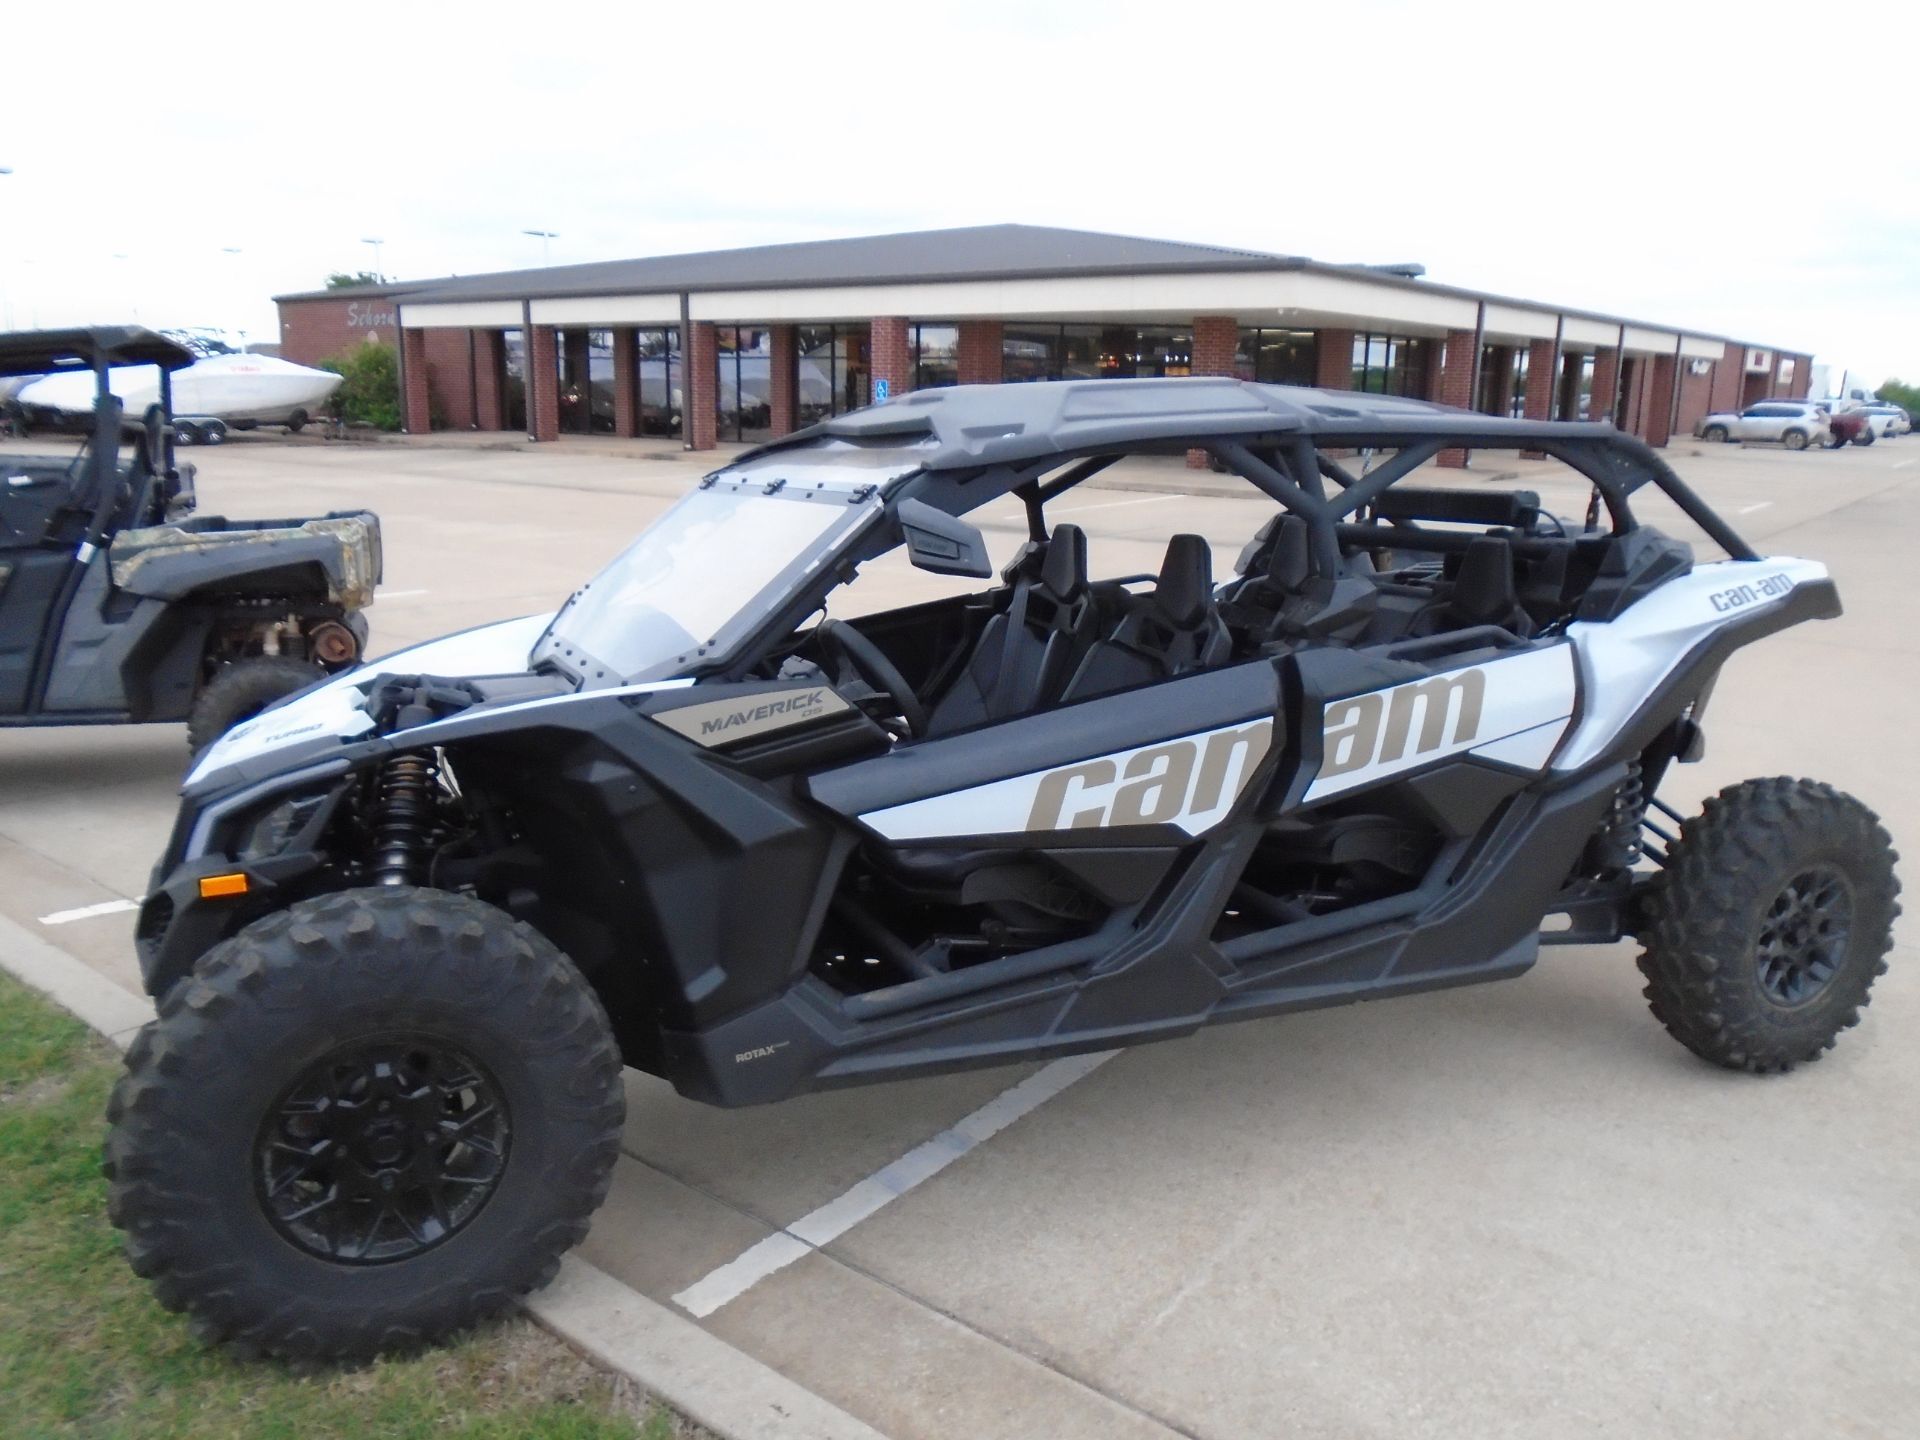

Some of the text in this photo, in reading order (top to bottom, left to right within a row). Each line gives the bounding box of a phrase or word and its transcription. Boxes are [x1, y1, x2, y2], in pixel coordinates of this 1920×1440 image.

[1709, 573, 1795, 612] can-am
[701, 690, 824, 735] MAVERICK
[735, 1045, 775, 1063] ROTAX
